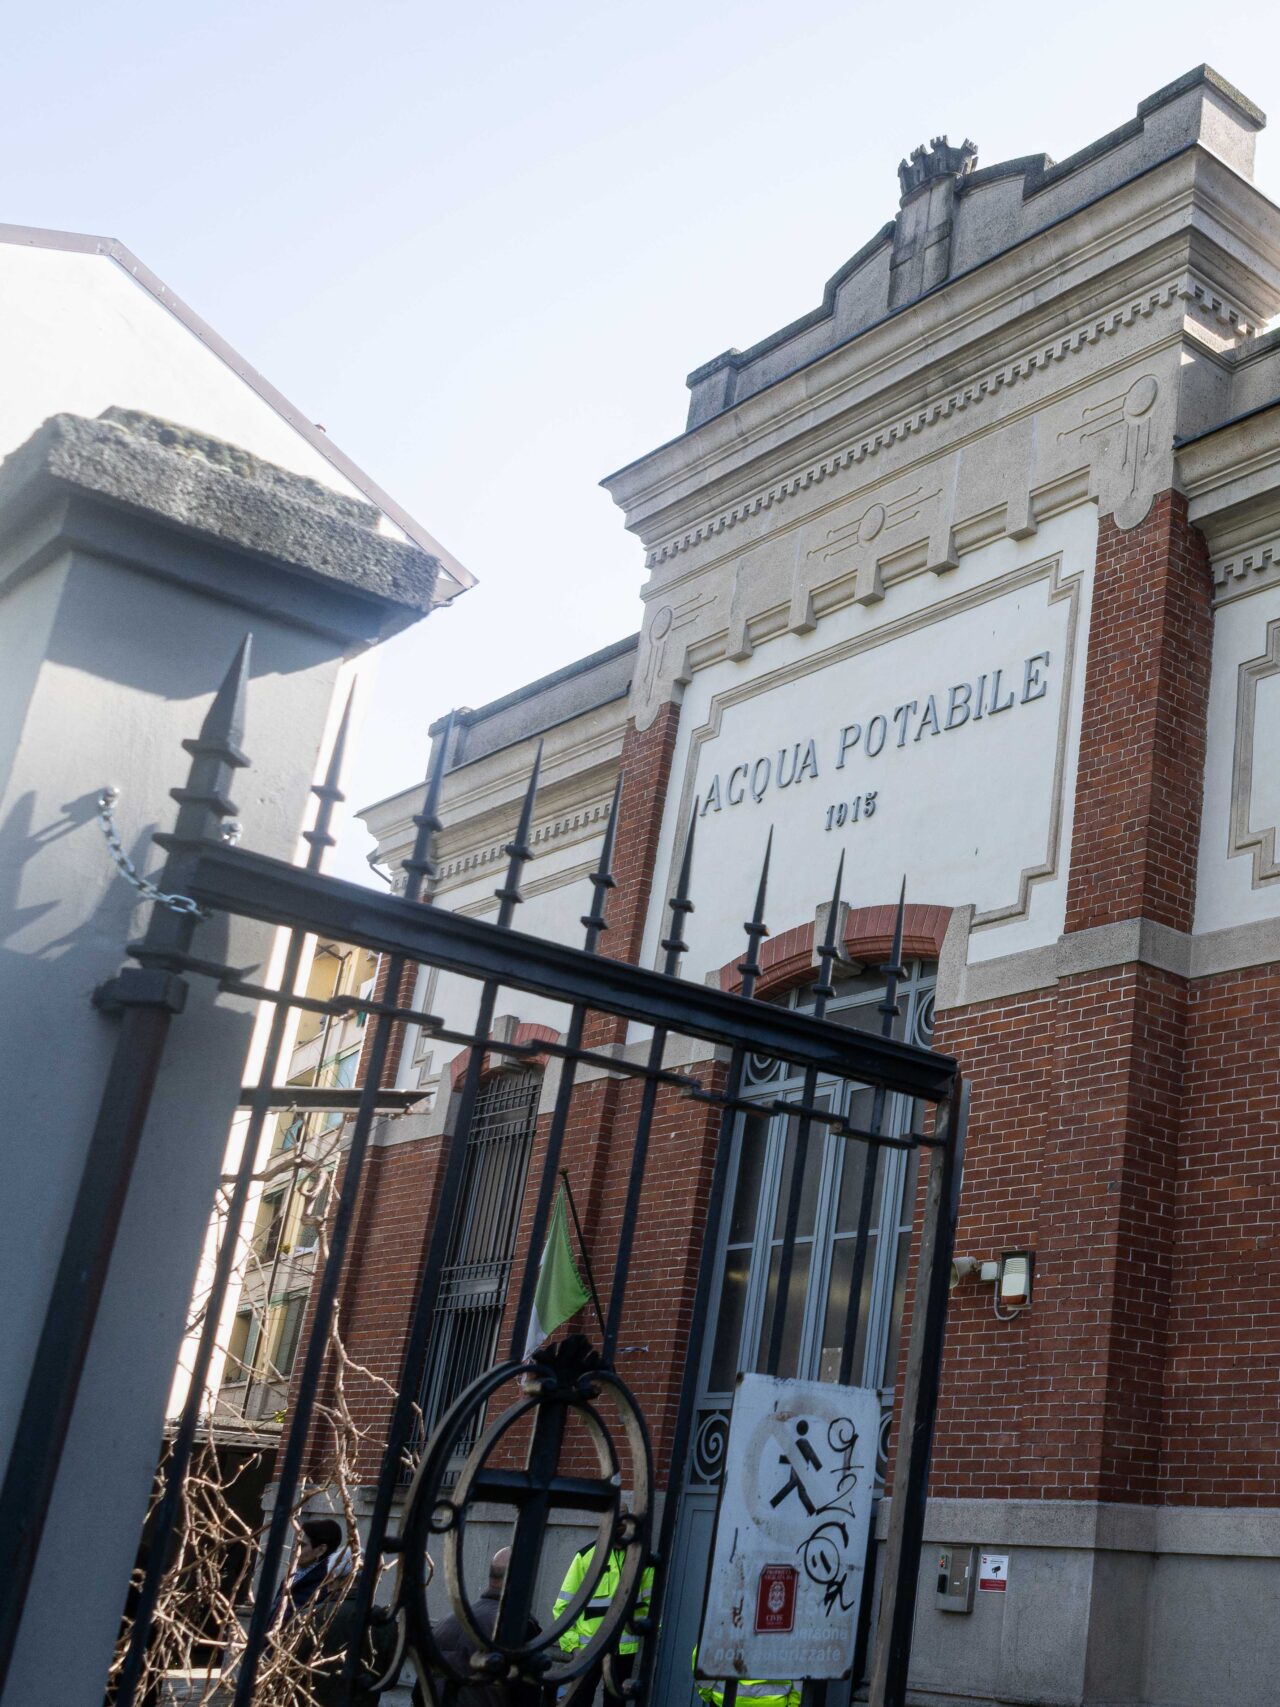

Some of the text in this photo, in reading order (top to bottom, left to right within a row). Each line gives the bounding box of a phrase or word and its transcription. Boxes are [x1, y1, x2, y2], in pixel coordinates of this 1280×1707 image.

[699, 650, 1050, 817] ACQUA POTABILE
[825, 791, 879, 831] 1915
